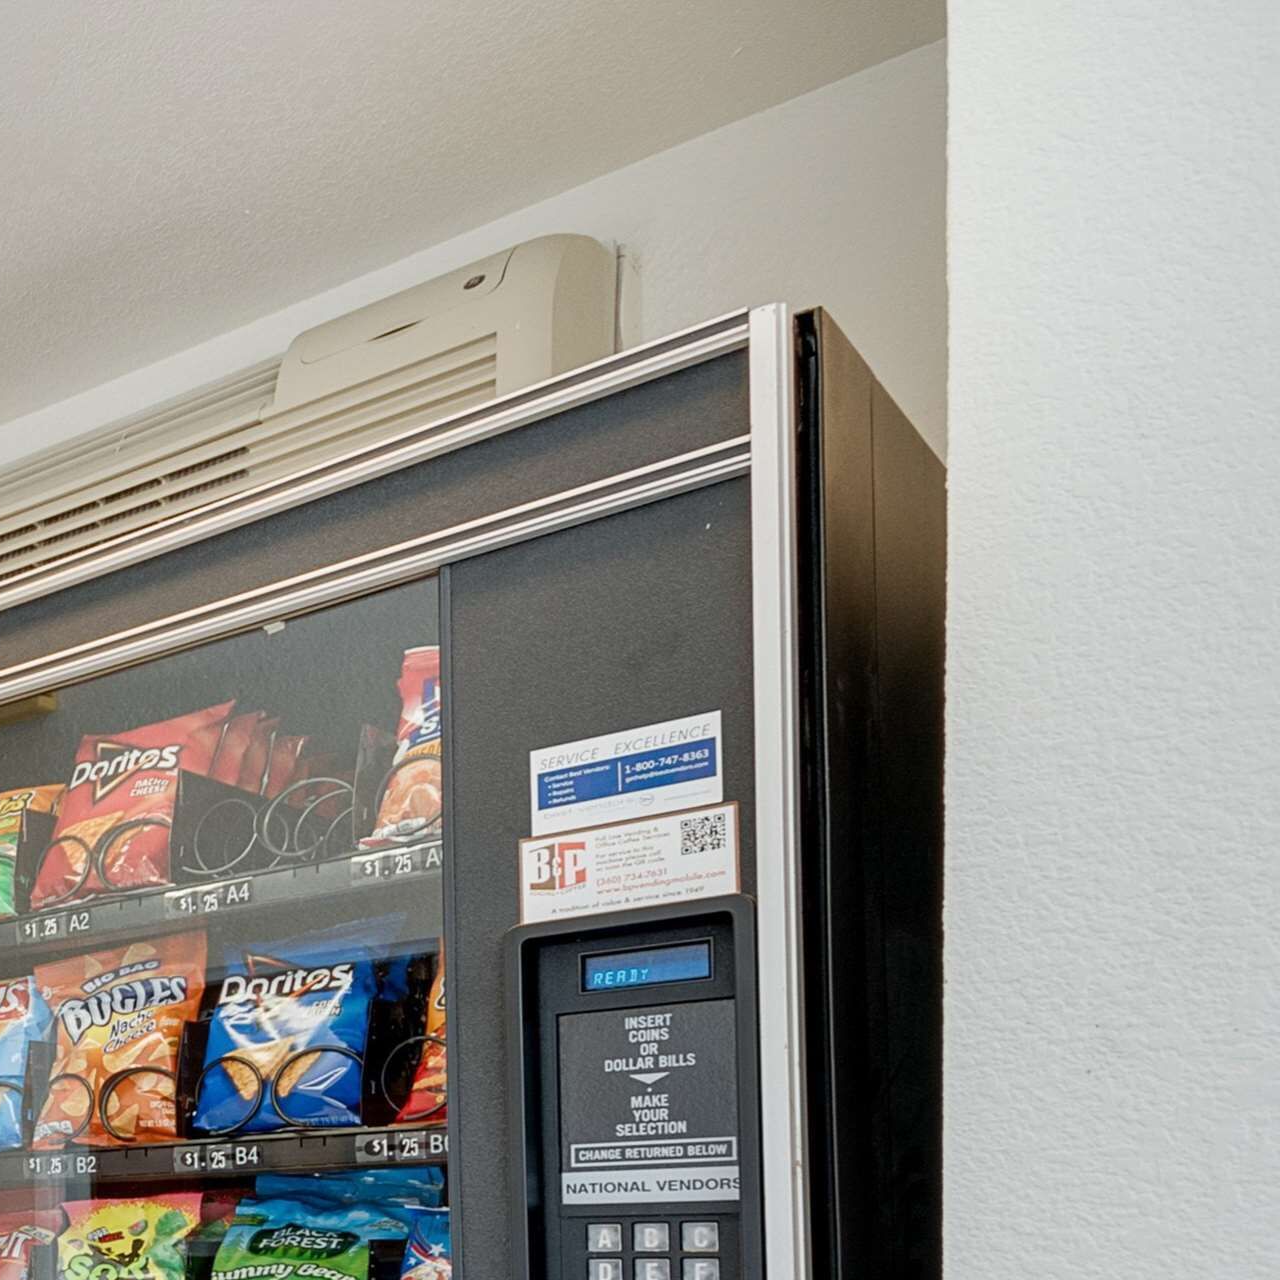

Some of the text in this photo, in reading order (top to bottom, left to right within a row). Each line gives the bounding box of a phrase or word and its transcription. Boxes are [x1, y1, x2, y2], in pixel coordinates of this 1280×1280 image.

[540, 723, 711, 770] SERVICE EXCELLENCE
[71, 746, 180, 789] Doritos
[625, 749, 709, 774] 1-800-747-8363
[226, 884, 250, 903] A4
[70, 912, 89, 932] A2
[82, 960, 160, 993] BIG BAG
[218, 963, 354, 1005] Doritos
[593, 968, 649, 985] READY
[60, 976, 187, 1045] BUGLES
[625, 1013, 672, 1030] INSERT
[629, 1028, 669, 1043] COINS
[640, 1044, 658, 1056] OR
[605, 1053, 696, 1072] DOLLAR BILLS
[630, 1094, 669, 1108] MAKE
[633, 1109, 669, 1122] YOUR
[616, 1121, 687, 1136] SELECTION
[235, 1146, 258, 1166] B4
[579, 1144, 728, 1162] CHANGE RETURNED BELOW
[77, 1156, 96, 1174] B2
[566, 1177, 741, 1194] NATIONAL VENDORS
[259, 1236, 343, 1249] FOREST
[598, 1226, 708, 1248] A C
